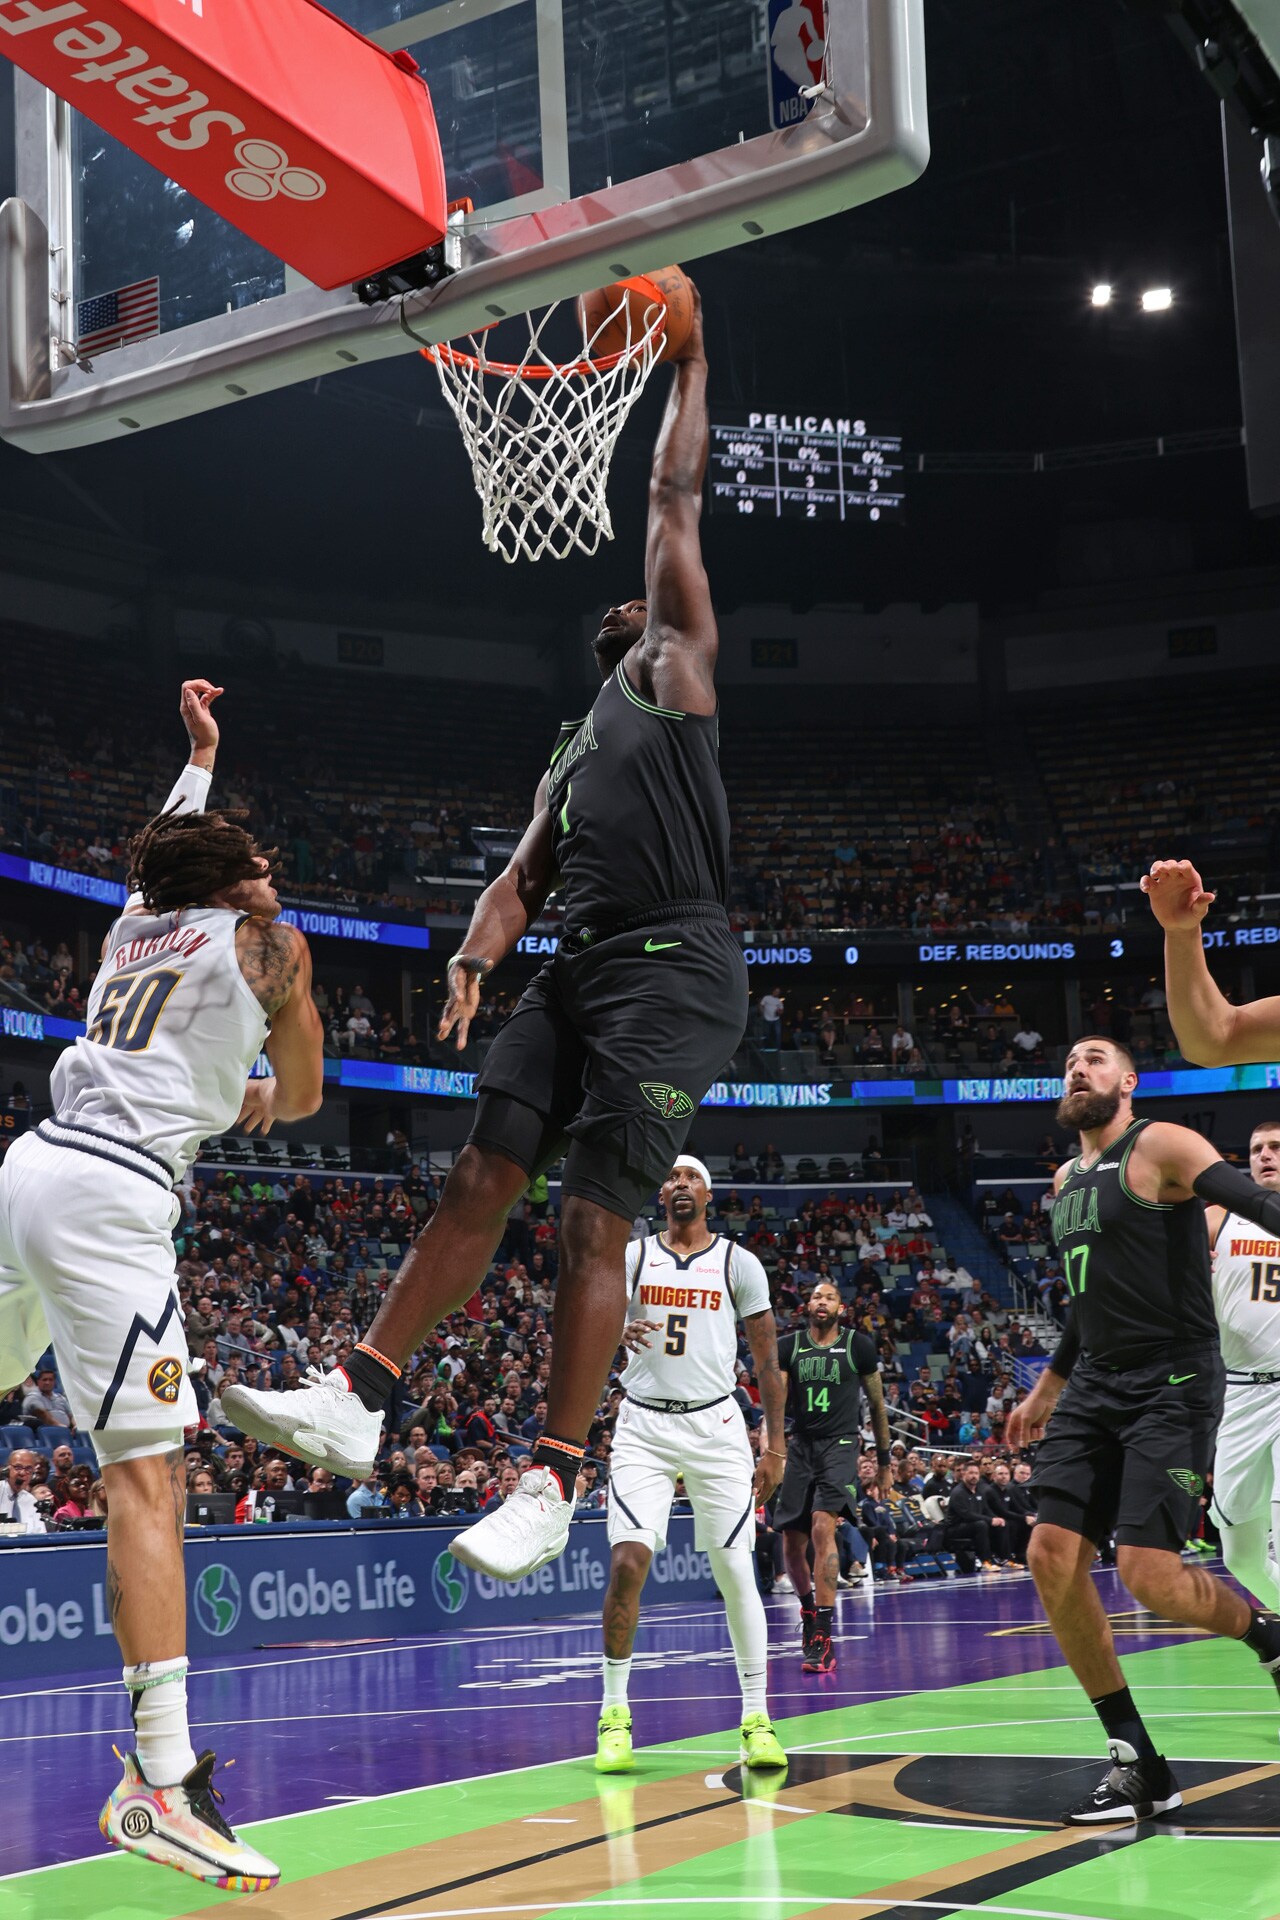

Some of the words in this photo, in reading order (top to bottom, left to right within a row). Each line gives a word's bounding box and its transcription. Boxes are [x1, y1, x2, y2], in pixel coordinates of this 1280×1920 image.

[780, 97, 808, 123] NBA
[749, 413, 867, 436] PELICANS
[727, 442, 764, 457] 100%
[798, 447, 820, 461] 0%
[862, 451, 884, 465] 0%
[736, 470, 747, 484] 0
[805, 474, 815, 488] 3
[869, 478, 879, 492] 3
[737, 500, 754, 514] 10
[807, 504, 816, 518] 2
[869, 507, 880, 521] 0
[340, 637, 382, 660] 320
[29, 860, 54, 886] NEW
[54, 867, 121, 904] AMSTERDAM
[300, 898, 335, 910] COMMUNITY
[336, 903, 360, 913] TICKETS
[301, 913, 340, 937] YOUR
[340, 918, 381, 942] WINS
[1201, 931, 1230, 949] OT.
[1235, 926, 1280, 946] REB
[115, 926, 211, 971] GORDON
[743, 947, 813, 965] OUNDS
[844, 946, 859, 965] 0
[918, 944, 962, 963] DEF.
[966, 942, 1076, 961] REBOUNDS
[1110, 939, 1125, 958] 3
[84, 965, 186, 1053] 50
[402, 1065, 431, 1090] NEW
[731, 1083, 777, 1105] YOUR
[778, 1083, 832, 1106] WINS
[958, 1079, 990, 1101] NEW
[1050, 1186, 1102, 1247] NOLA
[1230, 1239, 1280, 1258] NUGG
[1063, 1244, 1089, 1297] 17
[1250, 1261, 1280, 1304] 15
[639, 1284, 723, 1312] NUGGETS
[663, 1313, 689, 1358] 5
[798, 1356, 841, 1385] NOLA
[806, 1387, 831, 1413] 14
[558, 1547, 605, 1592] Life
[651, 1543, 713, 1584] Globe
[250, 1570, 352, 1620] Globe
[356, 1559, 416, 1611] Life
[0, 1587, 84, 1646] obe
